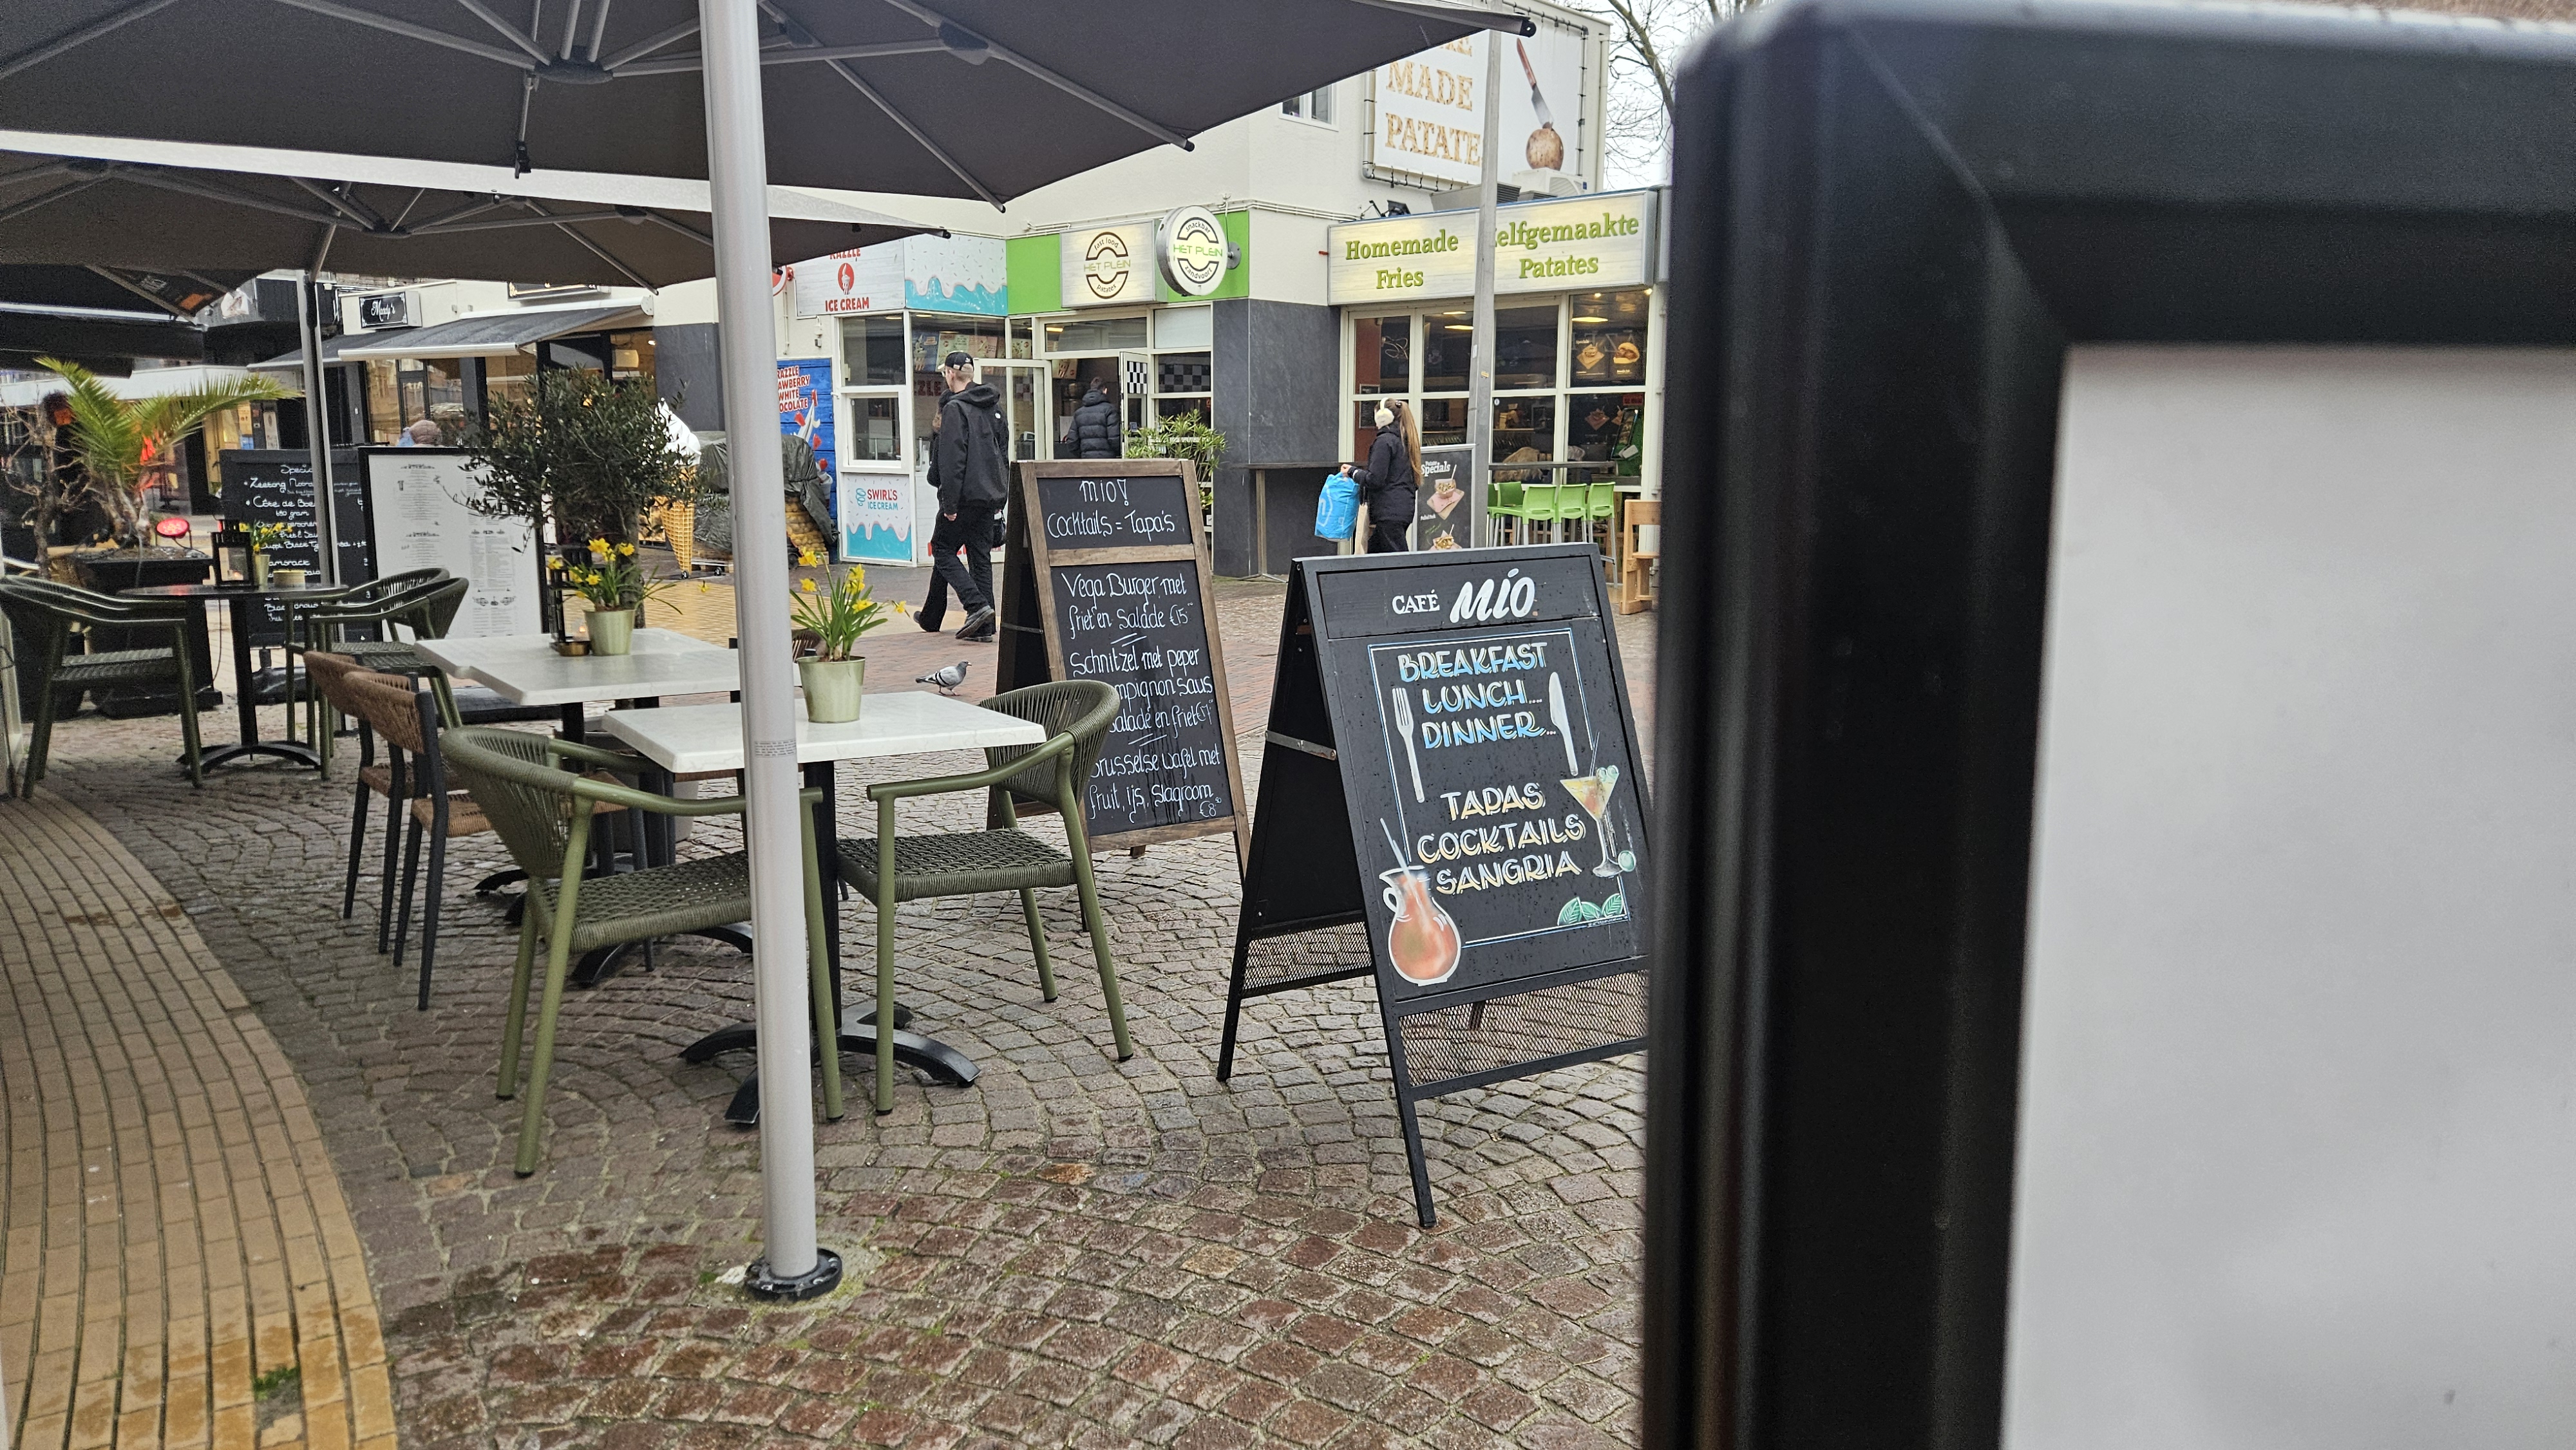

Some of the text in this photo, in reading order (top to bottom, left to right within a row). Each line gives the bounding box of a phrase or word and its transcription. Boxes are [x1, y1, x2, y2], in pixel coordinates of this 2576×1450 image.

[1385, 60, 1473, 111] MADE
[1385, 112, 1481, 167] PATATE
[1186, 221, 1211, 234] snackbar
[1495, 212, 1639, 250] elfgemaakte
[1094, 237, 1119, 250] fast food
[1173, 244, 1223, 258] HET PLEIN
[1345, 229, 1459, 260] Homemade
[1083, 259, 1131, 272] HET PLEIN
[1184, 265, 1213, 279] zandvoort
[1376, 267, 1424, 289] Fries
[1519, 254, 1598, 279] Patates
[1097, 283, 1117, 293] patates
[825, 297, 869, 312] ICE CREAM
[778, 375, 810, 390] AWBERRY
[779, 389, 799, 401] WHITE
[779, 398, 808, 413] OCOLATE
[280, 464, 313, 475] Specia
[1420, 460, 1451, 477] Specials
[867, 489, 898, 501] SWIRL'S
[867, 501, 898, 511] ICE CREAM
[1124, 509, 1175, 542] Tapa's
[1061, 572, 1187, 616] Vega Burger met
[1392, 588, 1440, 615] CAFÉ
[1068, 605, 1095, 640] friet
[1096, 611, 1112, 628] en
[1069, 645, 1200, 678] Schnitzel met peper
[1397, 641, 1548, 683] BREAKFAST
[1113, 677, 1177, 713] mpignon
[1154, 710, 1171, 728] en
[1171, 704, 1198, 739] friet
[1161, 746, 1198, 779] wafel
[1198, 743, 1220, 767] met
[1439, 782, 1546, 821] TAPAS
[1417, 813, 1586, 864] COCKTAILS
[1435, 850, 1582, 895] SANGRIA
